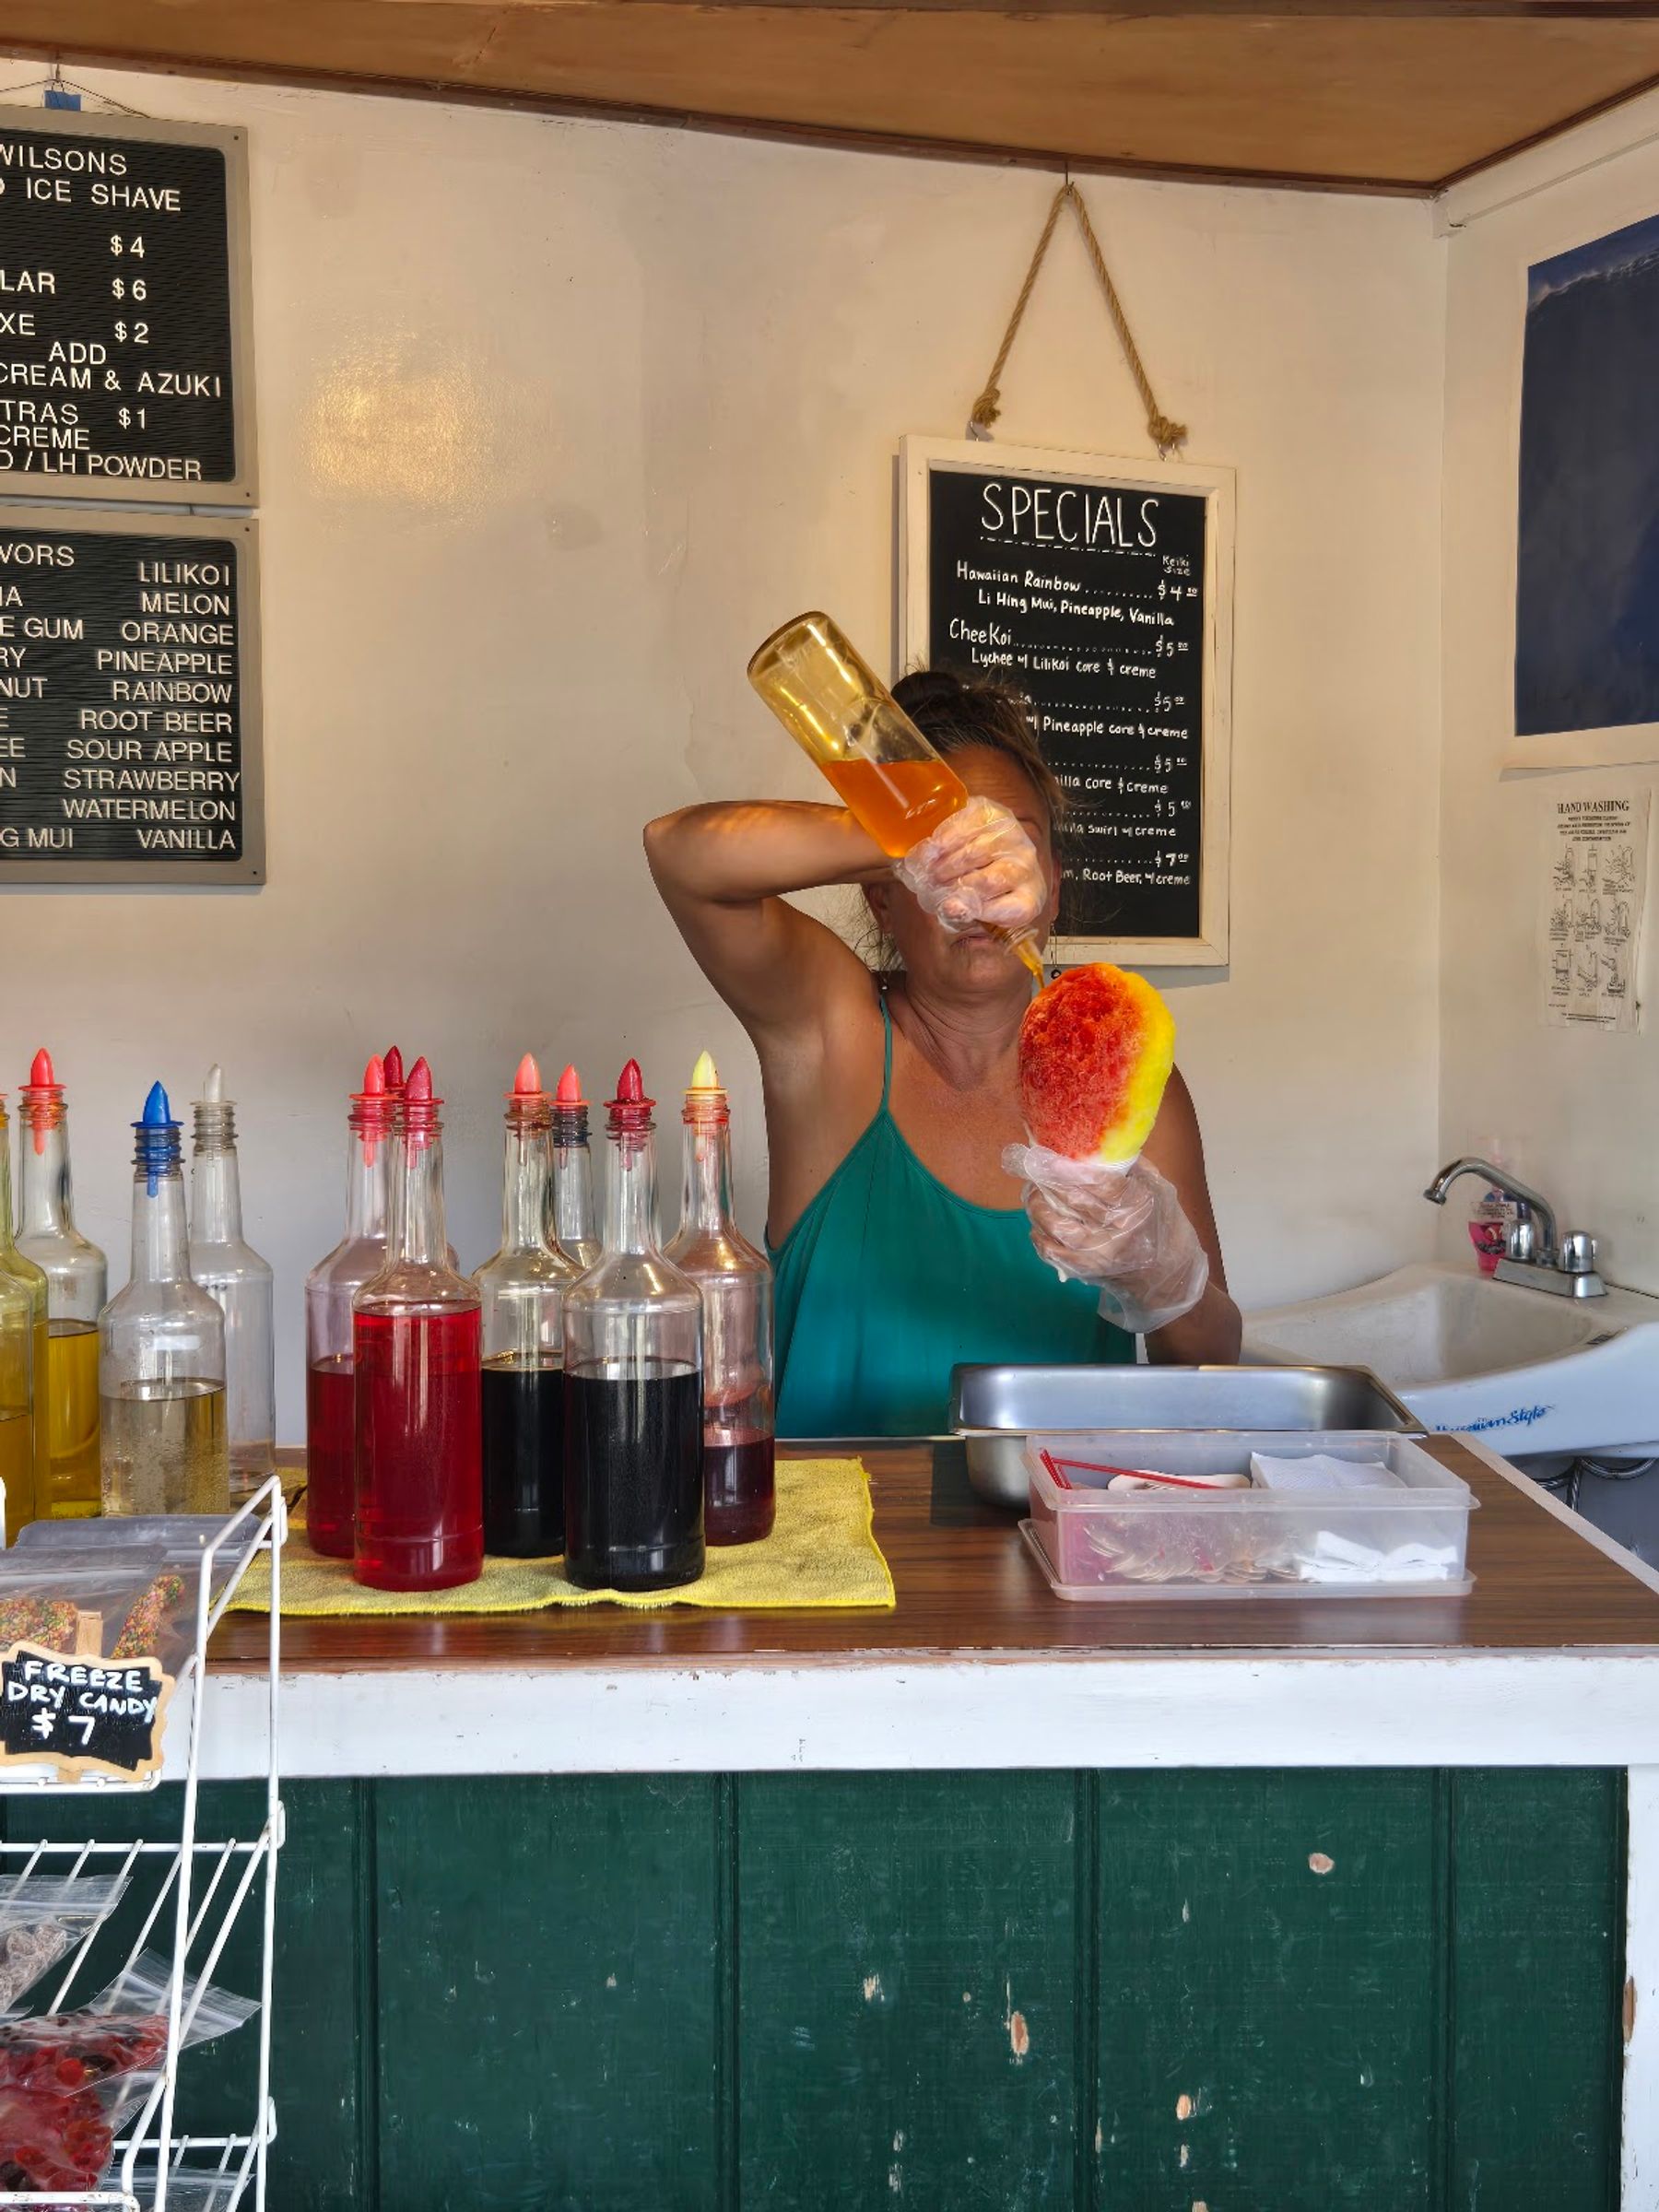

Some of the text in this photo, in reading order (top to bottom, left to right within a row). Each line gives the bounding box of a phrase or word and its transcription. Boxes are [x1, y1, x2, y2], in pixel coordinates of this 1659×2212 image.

[0, 144, 127, 174] WILSONS
[26, 176, 72, 203] ICE
[90, 183, 181, 212] SHAVE
[48, 341, 107, 365] ADD
[104, 370, 122, 392] &
[137, 371, 221, 398] AZUKI
[42, 452, 76, 475] LH
[88, 453, 202, 481] POWDER
[981, 483, 1159, 547] SPECIALS
[139, 561, 230, 586] LILIKOI
[956, 559, 1019, 583] Hawaiian
[1024, 570, 1082, 593] Rainbow
[140, 593, 230, 616] MELON
[978, 588, 992, 605] Li
[996, 592, 1029, 614] Hing
[1060, 599, 1124, 622] Pineapple,
[1129, 607, 1175, 627] Vanilla
[24, 618, 84, 641] GUM
[121, 621, 235, 645] ORANGE
[97, 649, 233, 675] PINEAPPLE
[971, 647, 1014, 668] Lychee
[1076, 660, 1101, 674] core
[1119, 664, 1157, 679] creme
[112, 680, 233, 703] RAINBOW
[79, 708, 232, 734] ROOT BEER
[1042, 715, 1104, 737] Pineapple
[1108, 724, 1135, 735] core
[1147, 726, 1189, 740] creme
[66, 739, 232, 763] SOUR APPLE
[63, 769, 241, 793] STRAWBERRY
[1084, 777, 1112, 790] core
[1126, 781, 1170, 795] creme
[62, 798, 236, 822] WATERMELON
[27, 828, 74, 849] MUI
[136, 829, 236, 851] VANILLA
[1135, 825, 1177, 838] creme
[1082, 867, 1112, 883] Root
[1155, 874, 1192, 887] creme
[24, 1660, 143, 1692] FREEZE
[7, 1680, 158, 1725] DRY CANDY
